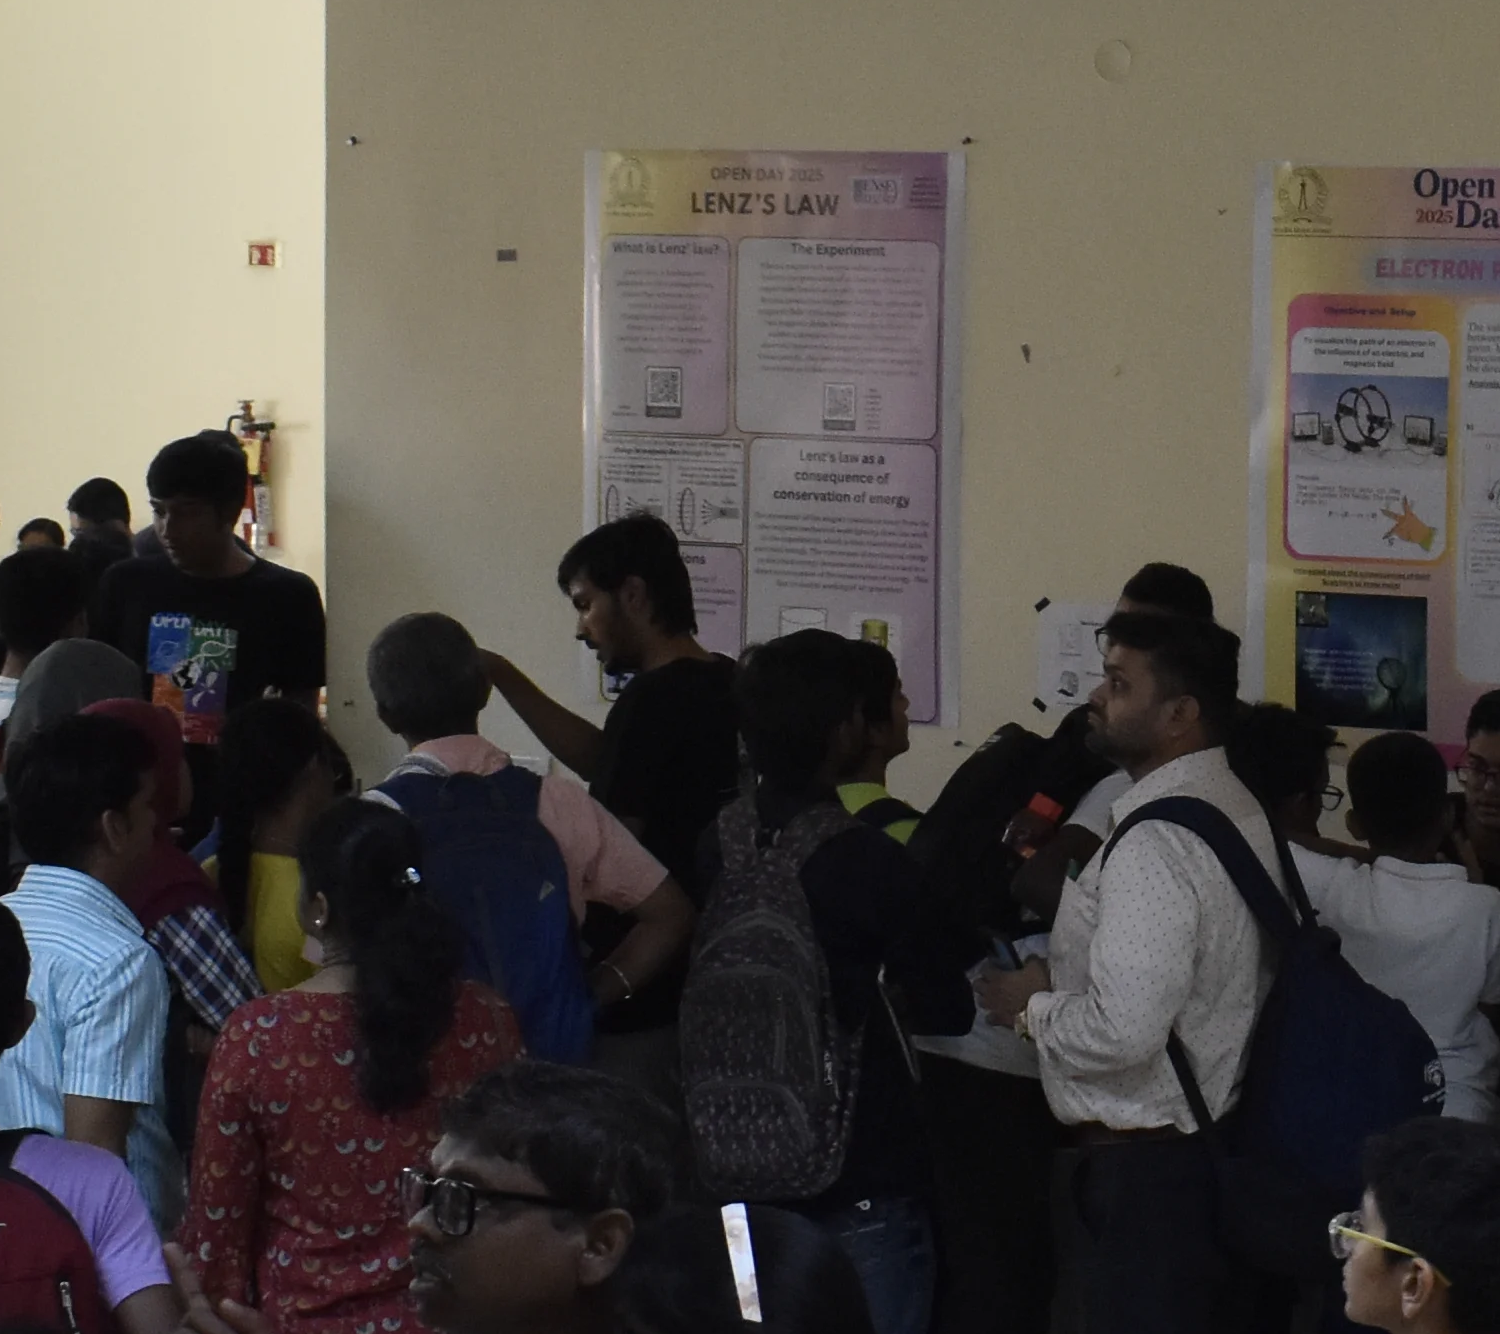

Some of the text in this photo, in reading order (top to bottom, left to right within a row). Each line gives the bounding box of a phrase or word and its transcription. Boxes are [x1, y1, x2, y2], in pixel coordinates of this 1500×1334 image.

[710, 166, 824, 183] OPEN DAY 2025
[1413, 168, 1496, 206] Open
[690, 191, 840, 216] LENZ'S LAW
[1415, 208, 1454, 224] 2025
[612, 241, 643, 254] What
[645, 242, 656, 254] is
[692, 243, 720, 256] law?
[790, 242, 886, 258] The Experiment
[1375, 258, 1484, 281] ELECTRON
[1468, 322, 1484, 333] The
[1359, 338, 1376, 346] path
[799, 449, 886, 466] Lenz's law as a
[793, 470, 891, 485] consequence of
[773, 489, 911, 509] conservation of energy
